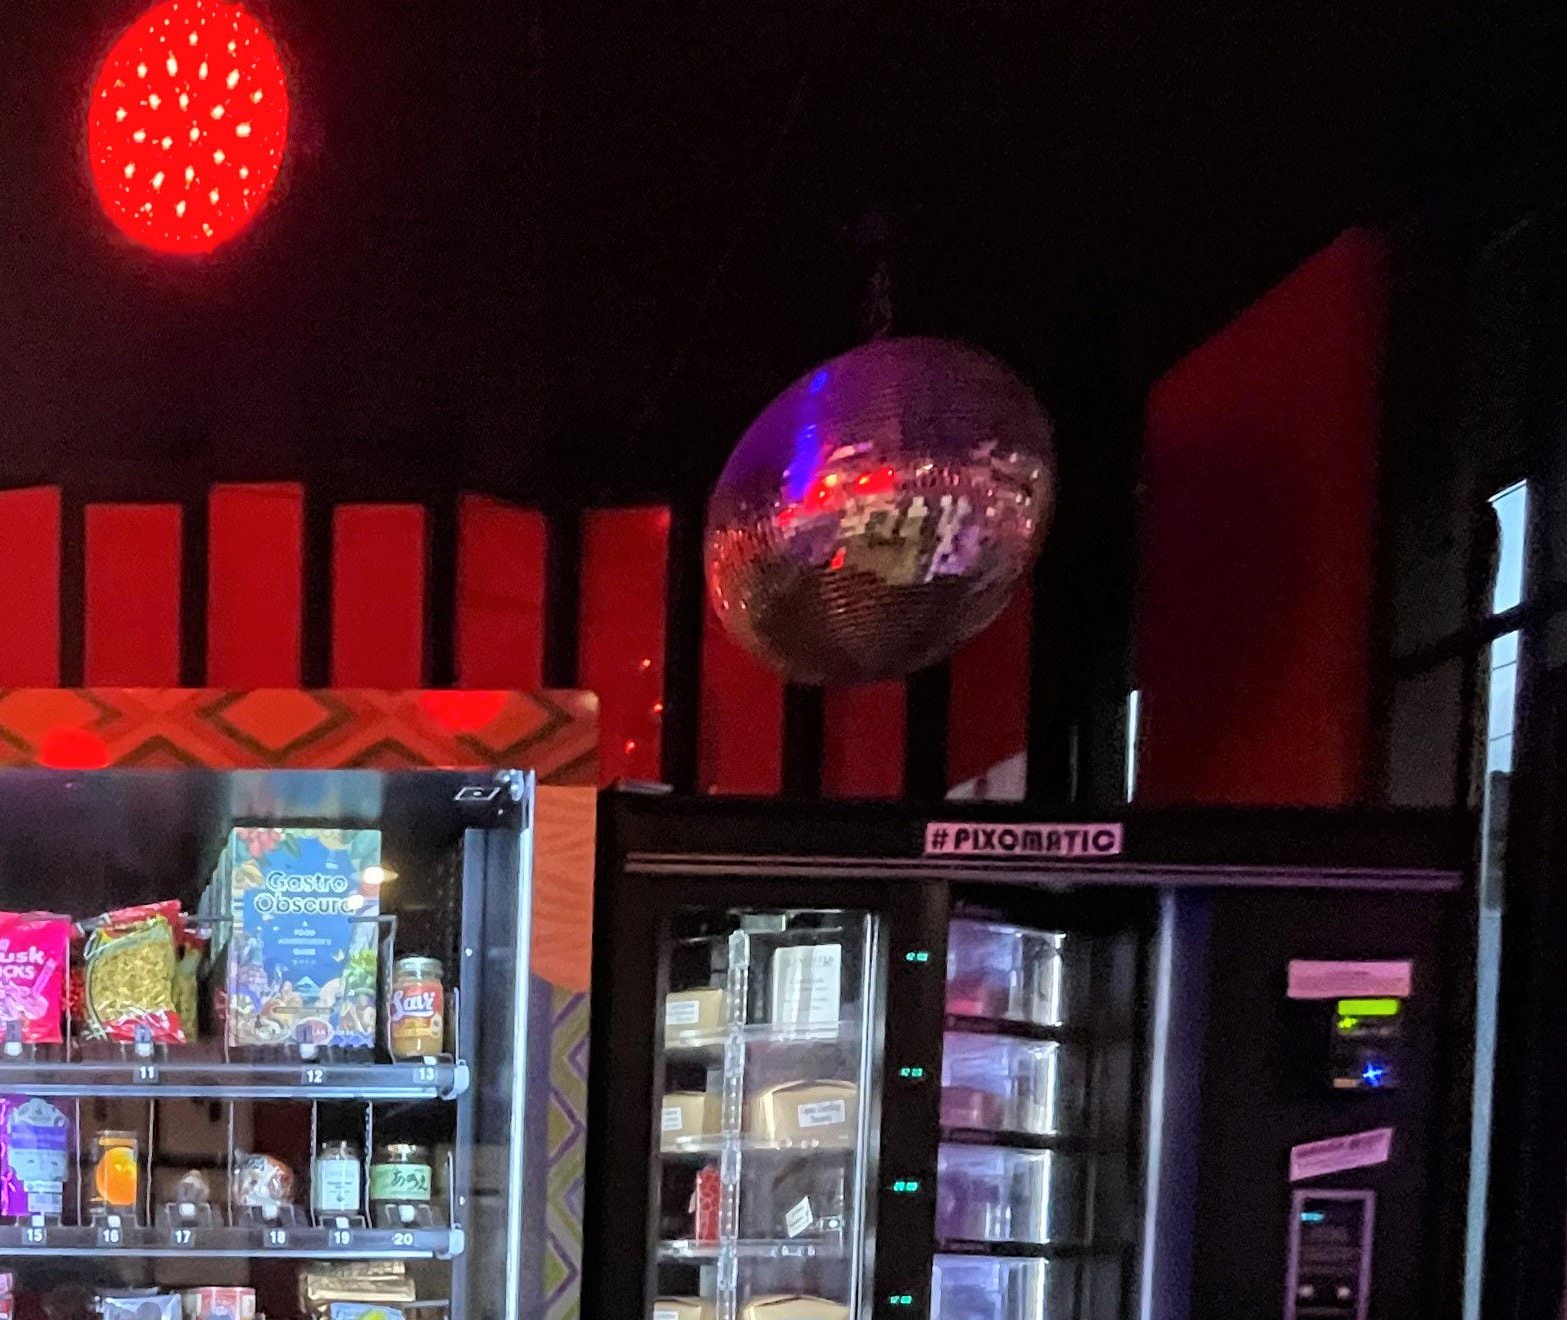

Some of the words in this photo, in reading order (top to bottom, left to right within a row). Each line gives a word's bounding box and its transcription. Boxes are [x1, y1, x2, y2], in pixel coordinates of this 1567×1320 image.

[932, 828, 1115, 852] #PIXOMATIC
[266, 870, 349, 893] Gastro
[253, 891, 357, 916] Obscura
[138, 1066, 155, 1079] 11
[306, 1069, 323, 1083] 12
[418, 1067, 436, 1082] 13
[27, 1229, 43, 1242] 15
[102, 1229, 119, 1243] 16
[175, 1230, 191, 1244] 17
[333, 1230, 350, 1245] 19
[392, 1232, 413, 1246] 20
